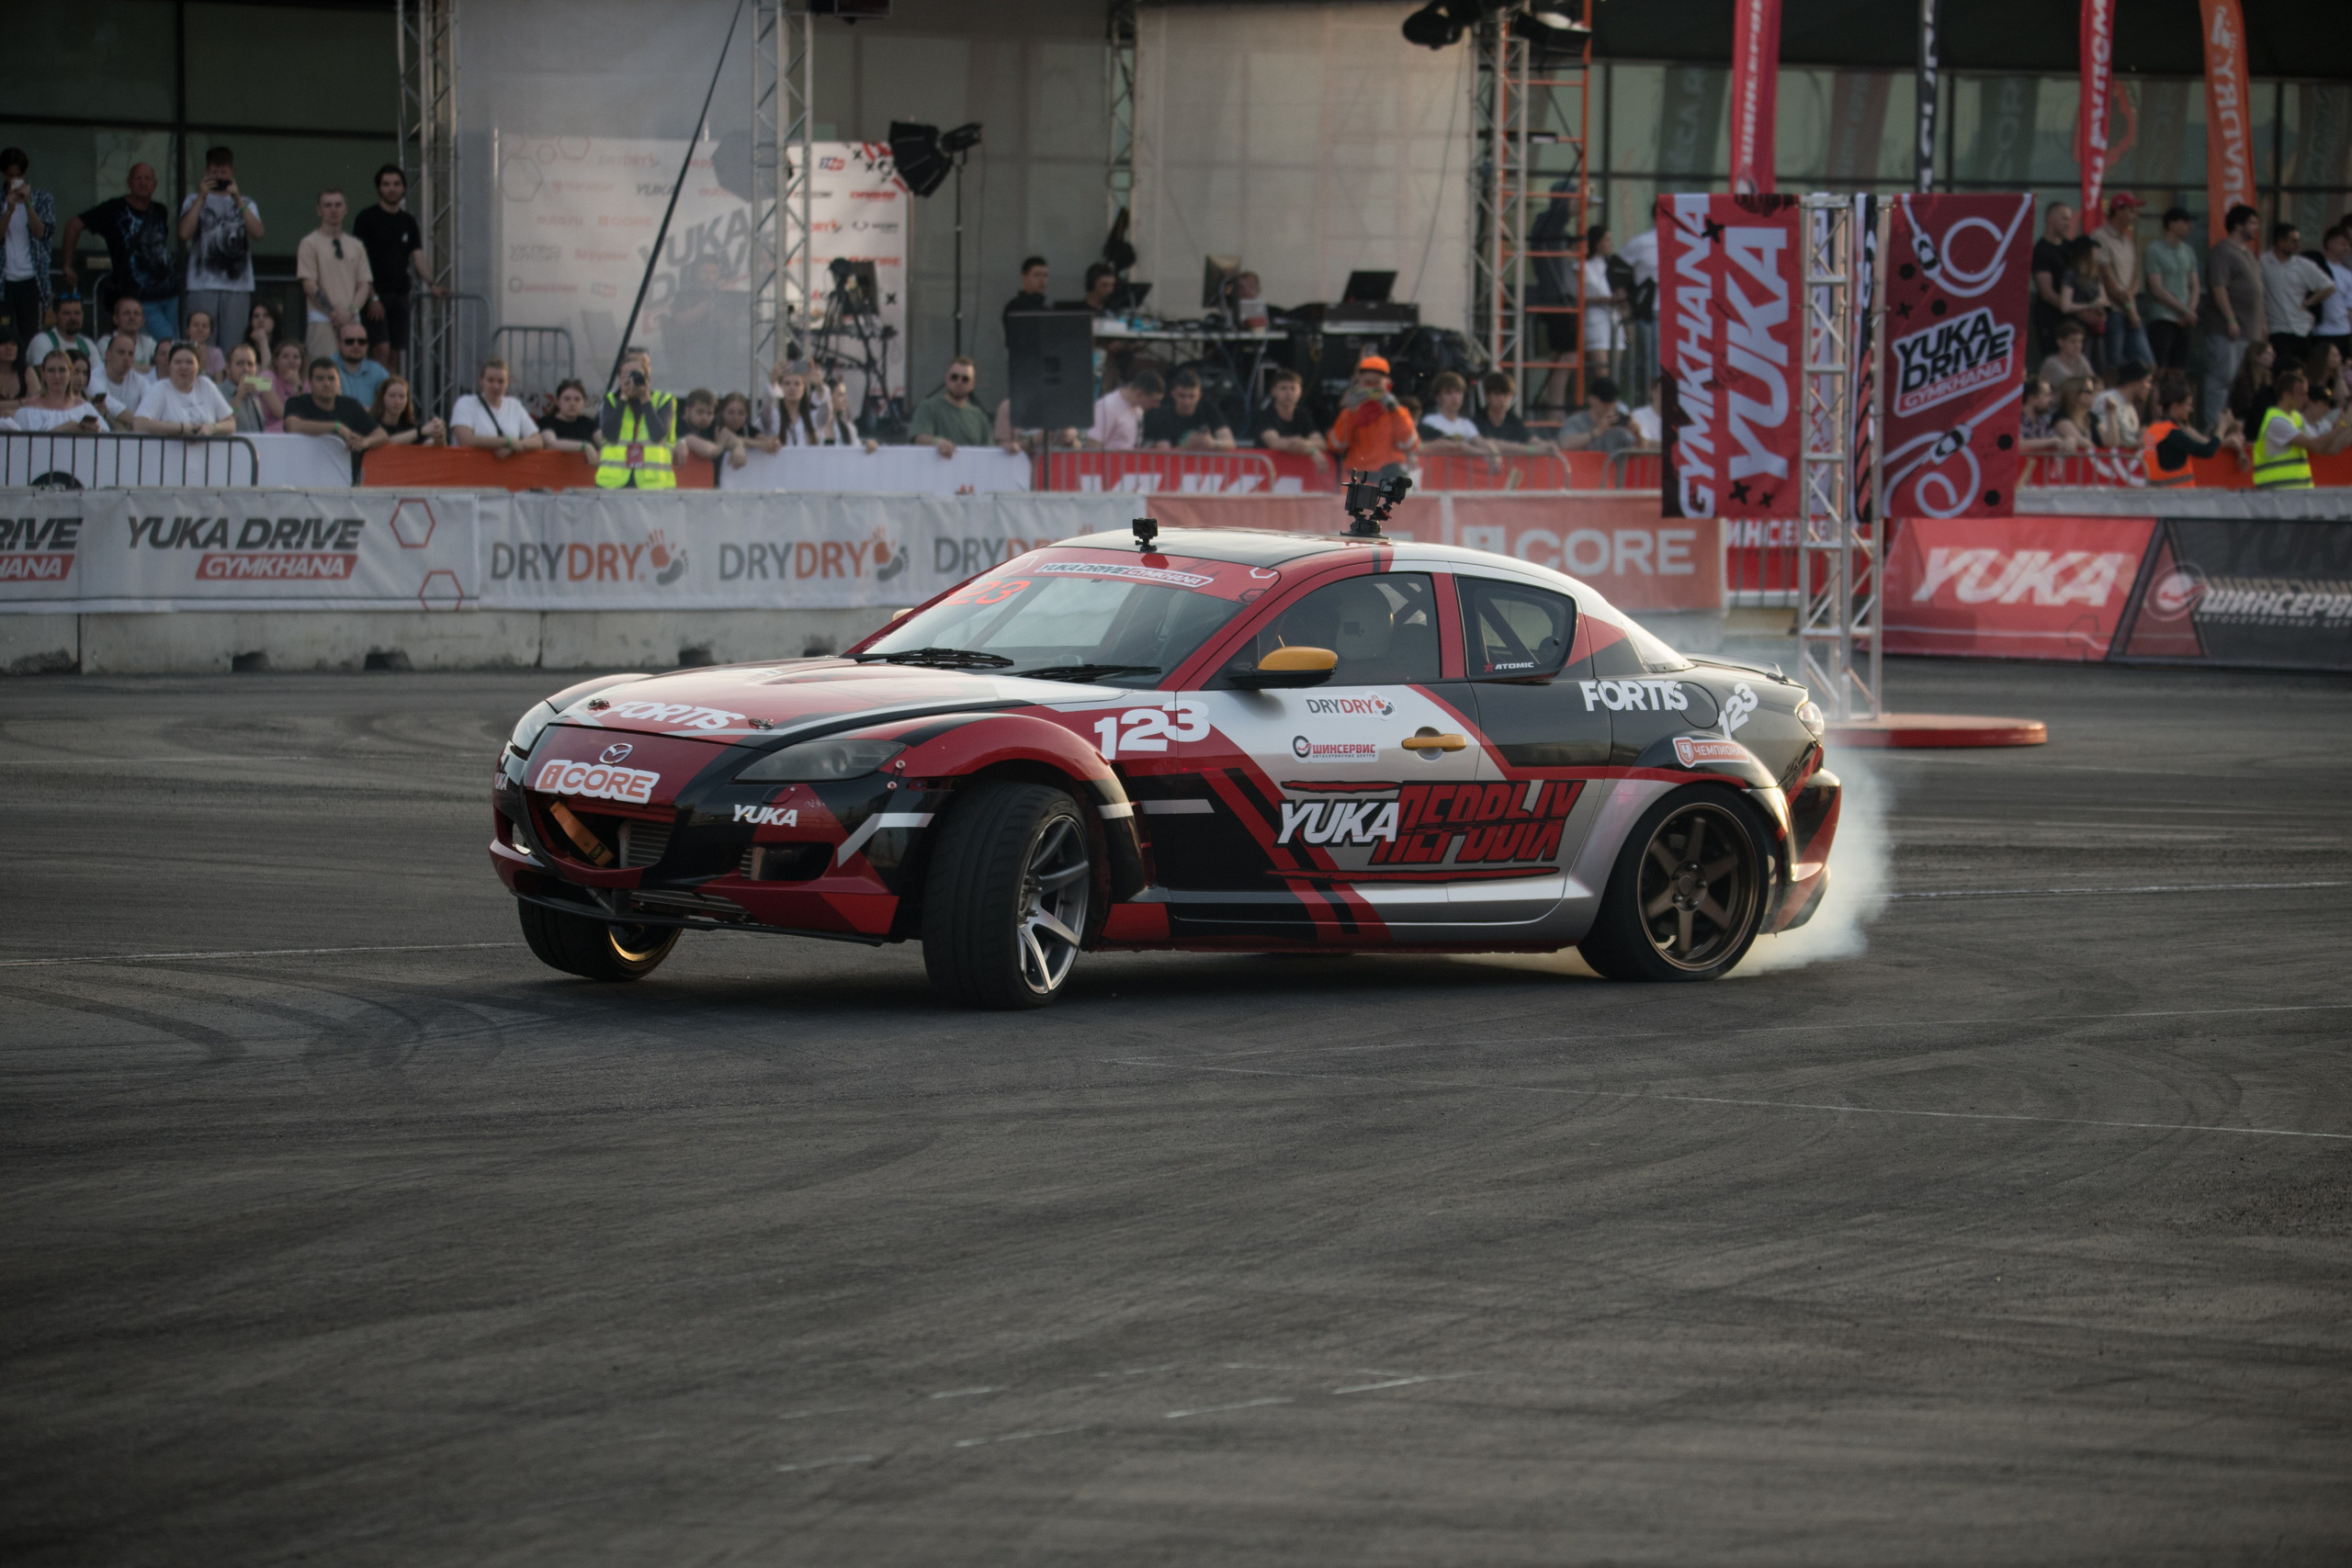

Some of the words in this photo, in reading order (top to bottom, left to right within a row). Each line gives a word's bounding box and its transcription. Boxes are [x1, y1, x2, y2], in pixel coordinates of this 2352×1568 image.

[1675, 194, 1714, 519] GYMKHANA
[1724, 226, 1789, 480] YUKA
[1898, 313, 1993, 366] YUKA
[1902, 332, 2012, 395] DRIVE
[1901, 363, 2004, 409] GYMKHANA
[128, 516, 229, 549] YUKA
[236, 517, 366, 550] DRIVE
[205, 555, 345, 579] GYMKHANA
[490, 543, 641, 581] DRYDRY
[719, 541, 868, 581] DRYDRY
[1079, 565, 1125, 575] DRIVE
[1127, 568, 1202, 585] GYMKHANA
[1911, 547, 2123, 607] YUKA
[944, 581, 1031, 605] 23
[1495, 661, 1533, 670] ATOMIC
[597, 701, 746, 730] FORTIS
[1306, 695, 1373, 715] DRYDRY
[1578, 681, 1688, 712] FORTIS
[1718, 682, 1758, 739] 123
[1093, 700, 1210, 760] 123
[1312, 744, 1375, 754] ШИНСЕРВИС
[733, 804, 797, 827] YUKA
[1277, 802, 1399, 844] YUKA
